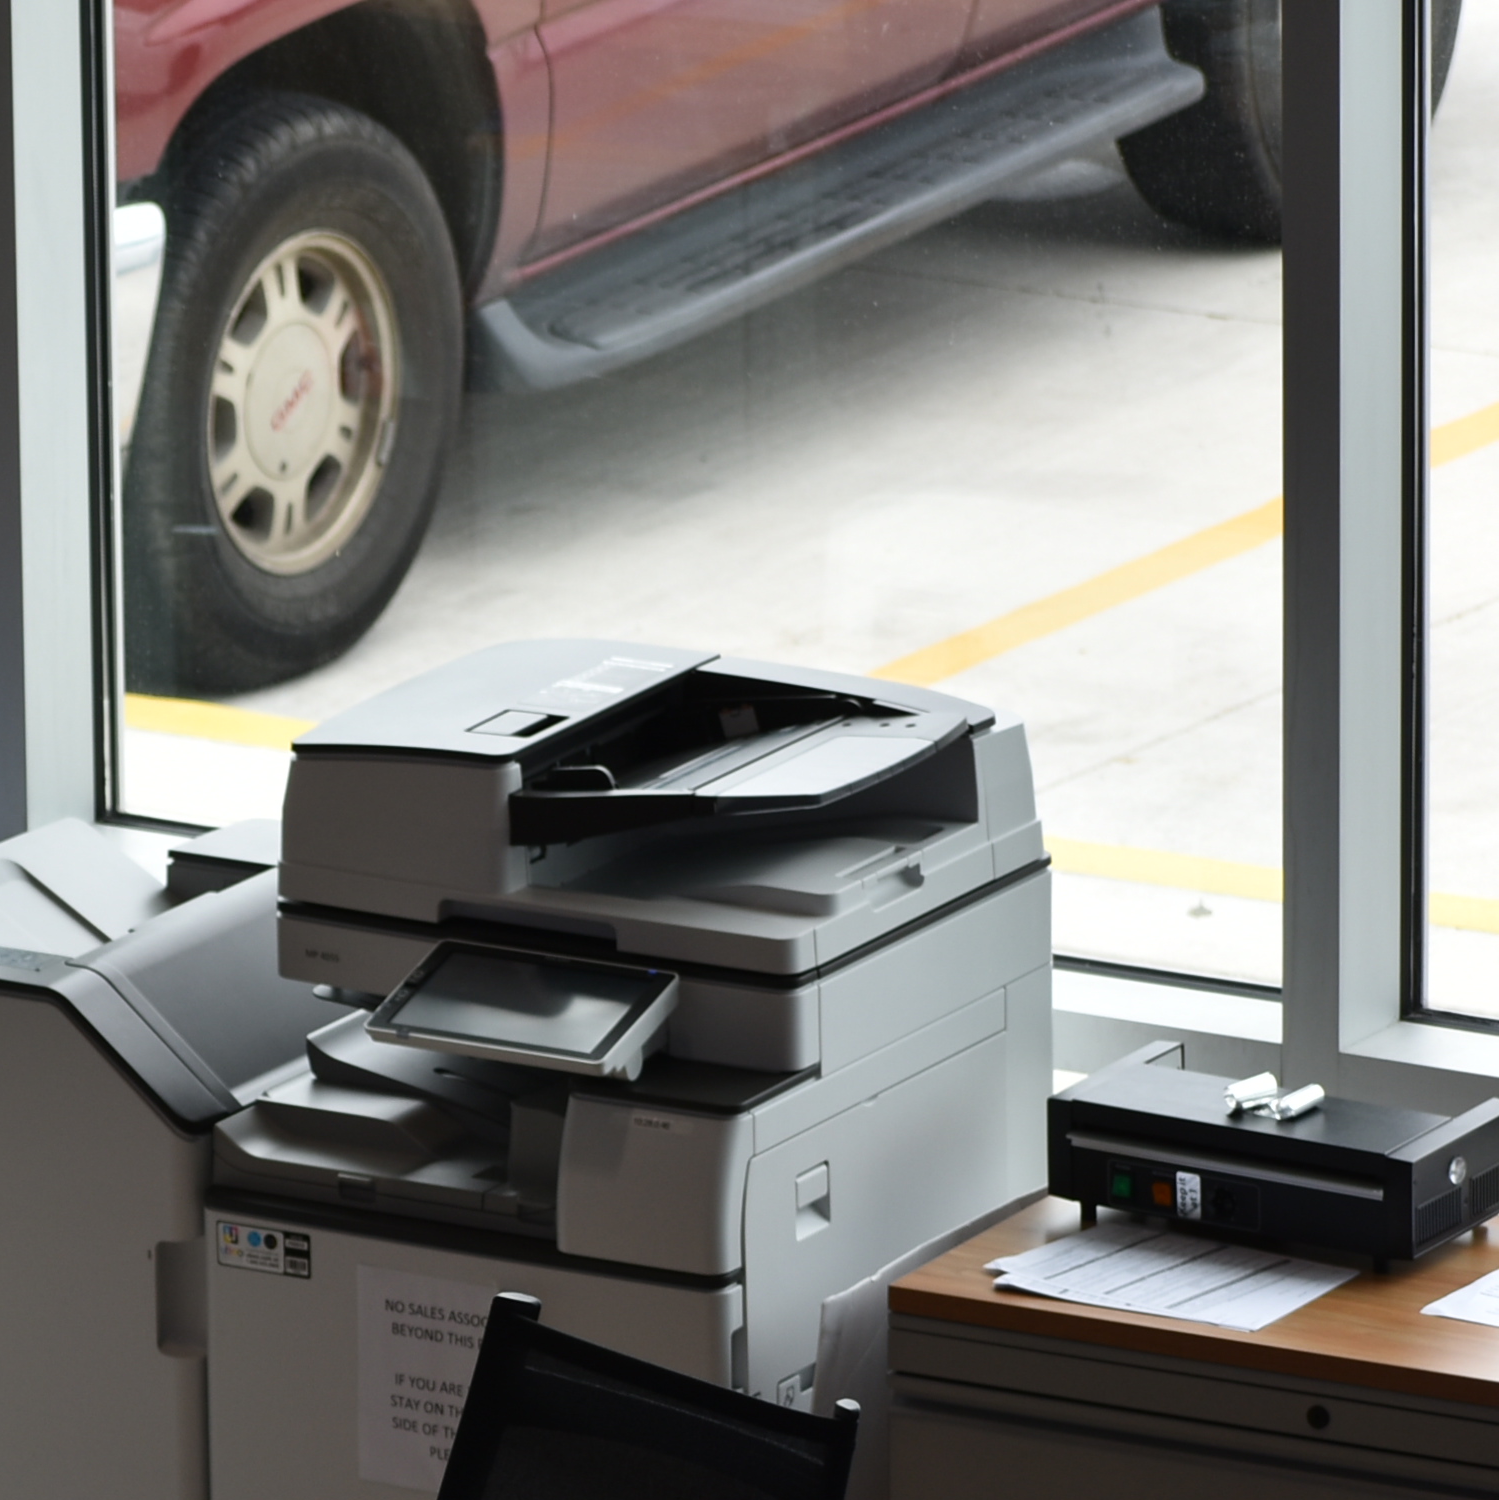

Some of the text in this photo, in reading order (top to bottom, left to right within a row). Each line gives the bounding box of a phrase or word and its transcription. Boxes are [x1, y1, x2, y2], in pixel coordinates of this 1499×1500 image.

[384, 1298, 406, 1314] NO
[408, 1302, 444, 1321] SALES
[391, 1322, 443, 1343] BEYOND
[447, 1332, 474, 1349] THIS
[394, 1373, 406, 1386] IF
[408, 1375, 435, 1393] YOU
[439, 1382, 463, 1398] ARE
[390, 1394, 420, 1412] STAY
[423, 1401, 444, 1416] ON
[391, 1416, 418, 1432] SIDE
[422, 1423, 438, 1437] OF
